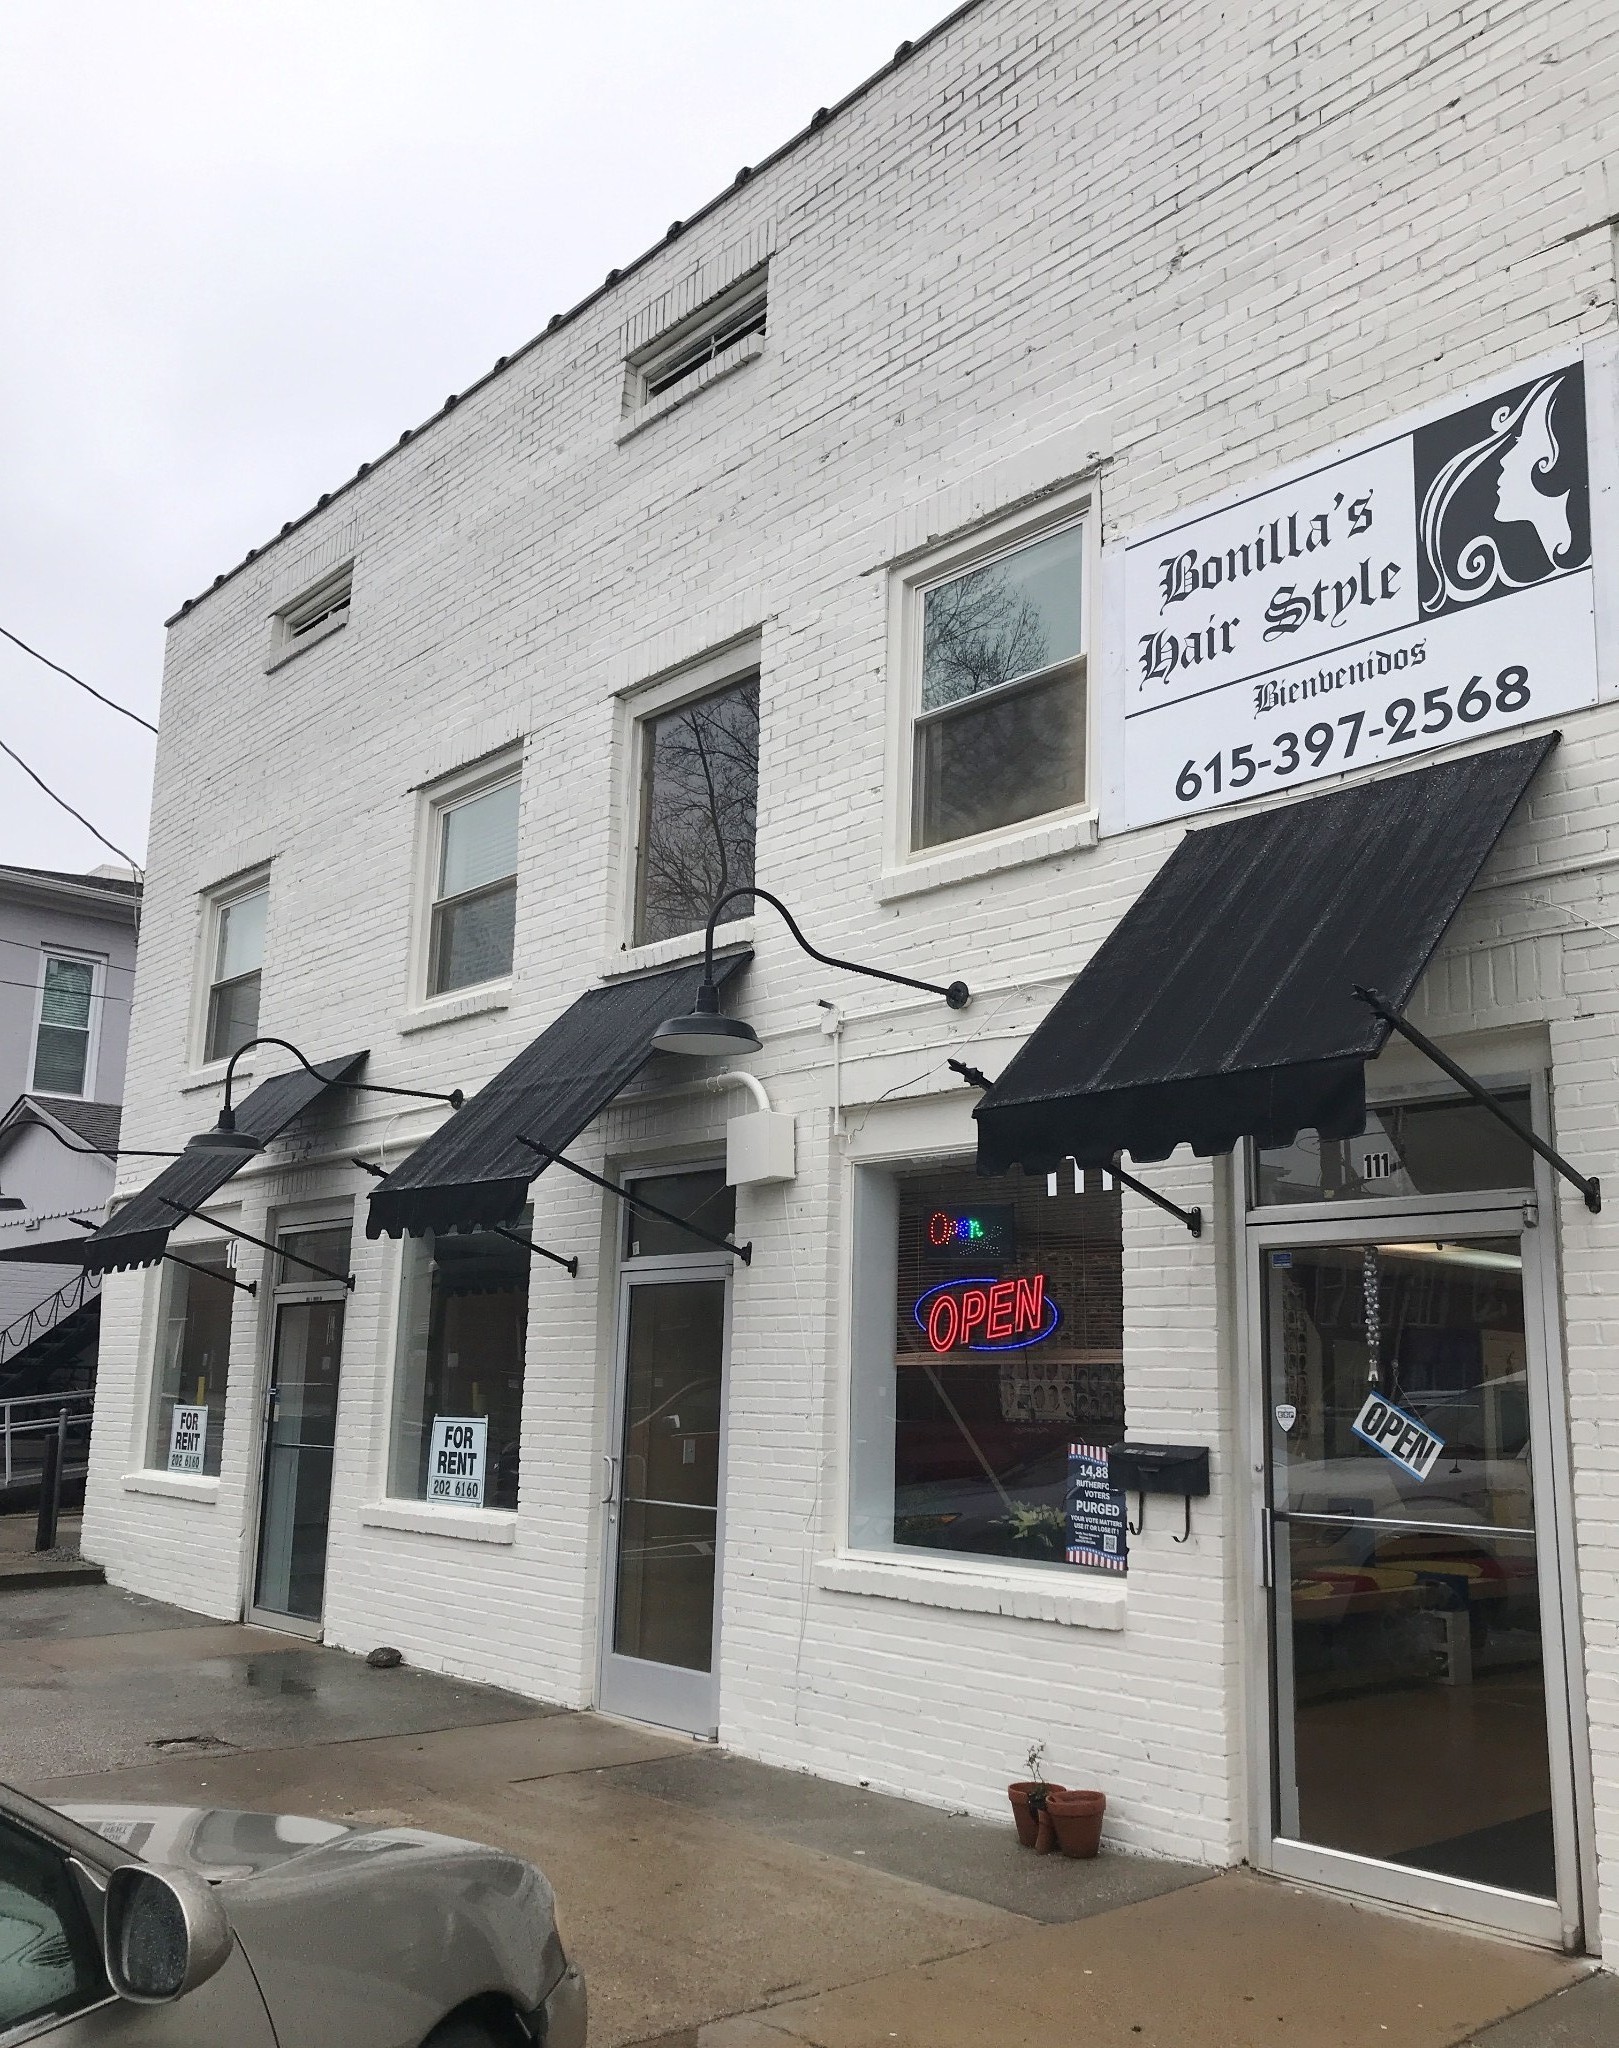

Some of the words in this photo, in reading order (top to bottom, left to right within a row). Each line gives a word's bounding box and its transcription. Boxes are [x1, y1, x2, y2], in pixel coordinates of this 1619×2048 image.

[1158, 488, 1374, 616] Bonilla's
[1138, 614, 1240, 692] Hair
[1262, 557, 1402, 643] Style
[1252, 638, 1428, 720] Bienvenidos
[1175, 664, 1532, 802] 615-397-2568
[1365, 1153, 1389, 1178] 111
[930, 1212, 984, 1245] Open
[929, 1274, 1044, 1352] OPEN
[180, 1412, 199, 1431] FOR
[175, 1432, 201, 1452] RENT
[444, 1425, 474, 1450] FOR
[1361, 1401, 1437, 1473] OPEN
[171, 1454, 182, 1467] 202
[184, 1455, 200, 1469] 6160
[437, 1450, 478, 1476] RENT
[1080, 1464, 1109, 1480] 14,88
[433, 1479, 451, 1495] 202
[455, 1481, 479, 1498] 6160
[1076, 1479, 1118, 1491] RUTHERFO
[1084, 1490, 1111, 1501] VOTERS
[1076, 1500, 1120, 1517] PURGED
[1071, 1515, 1085, 1523] YOUR
[1086, 1517, 1099, 1525] VOTE
[1100, 1519, 1123, 1528] MATTERS
[1074, 1522, 1084, 1530] USE
[1098, 1526, 1111, 1534] LOSE
